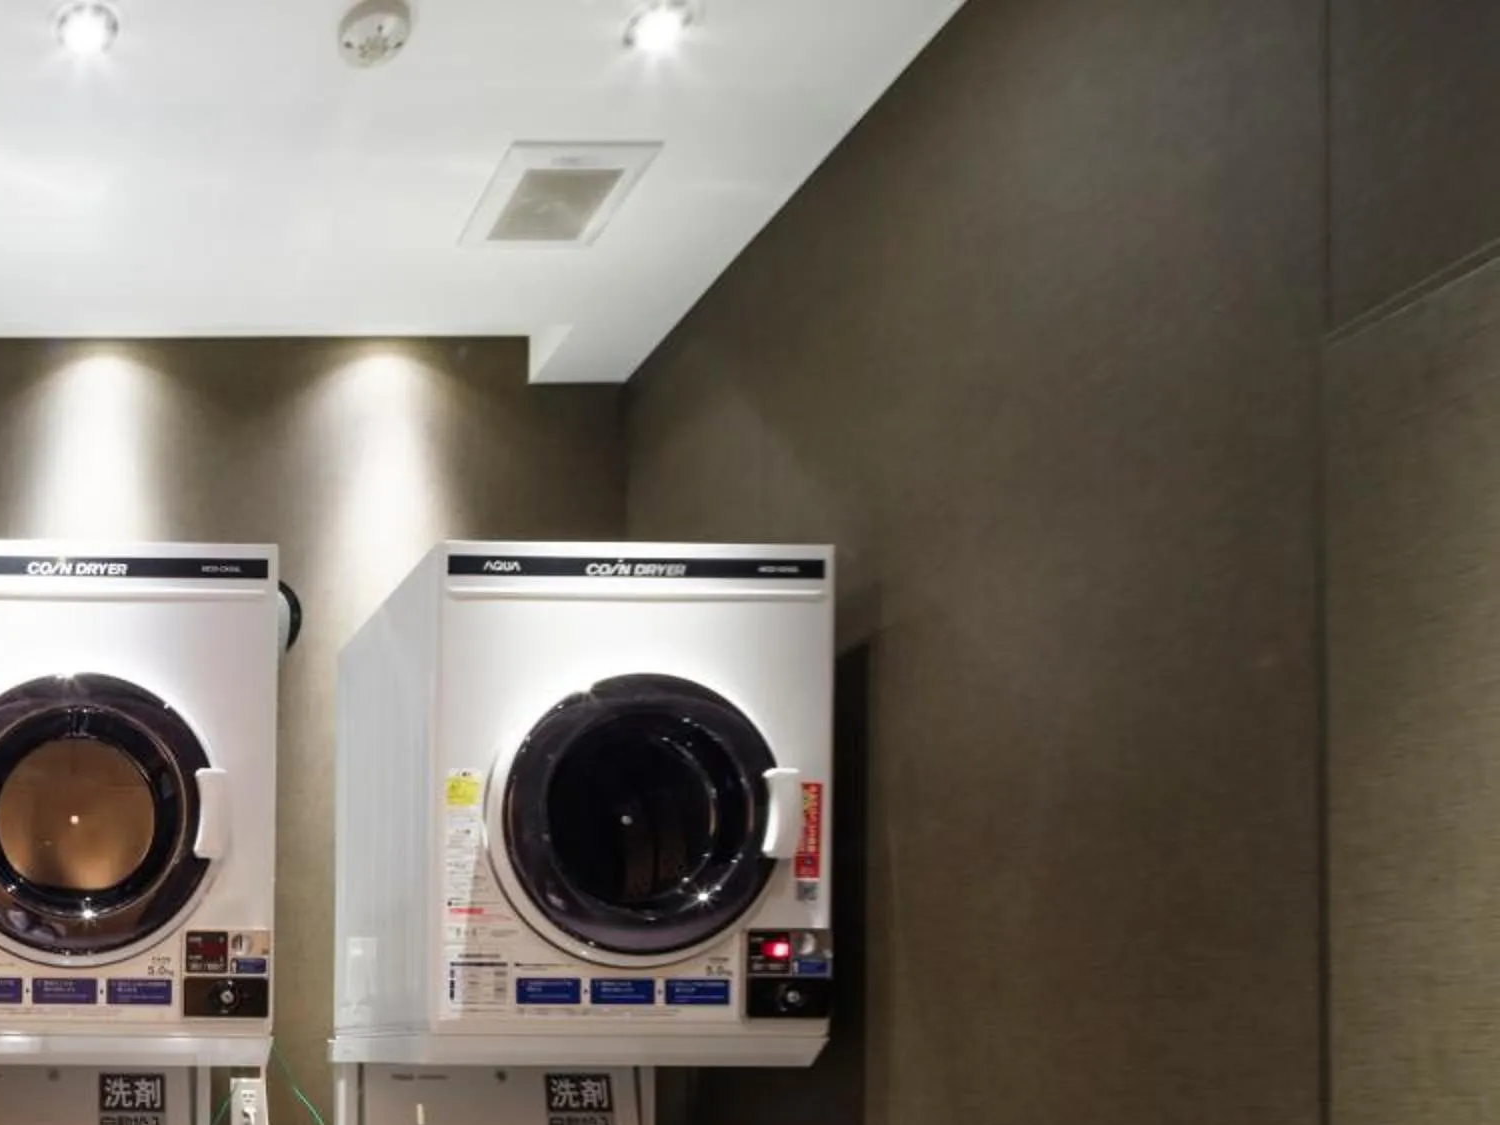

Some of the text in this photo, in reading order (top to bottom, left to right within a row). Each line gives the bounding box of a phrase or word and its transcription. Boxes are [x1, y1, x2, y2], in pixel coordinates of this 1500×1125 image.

[27, 559, 128, 576] COIN DRYER
[483, 560, 521, 572] AQUA
[585, 559, 687, 576] COIN DRYER
[104, 1077, 161, 1109] 洗剤
[550, 1078, 609, 1109] 洗剤
